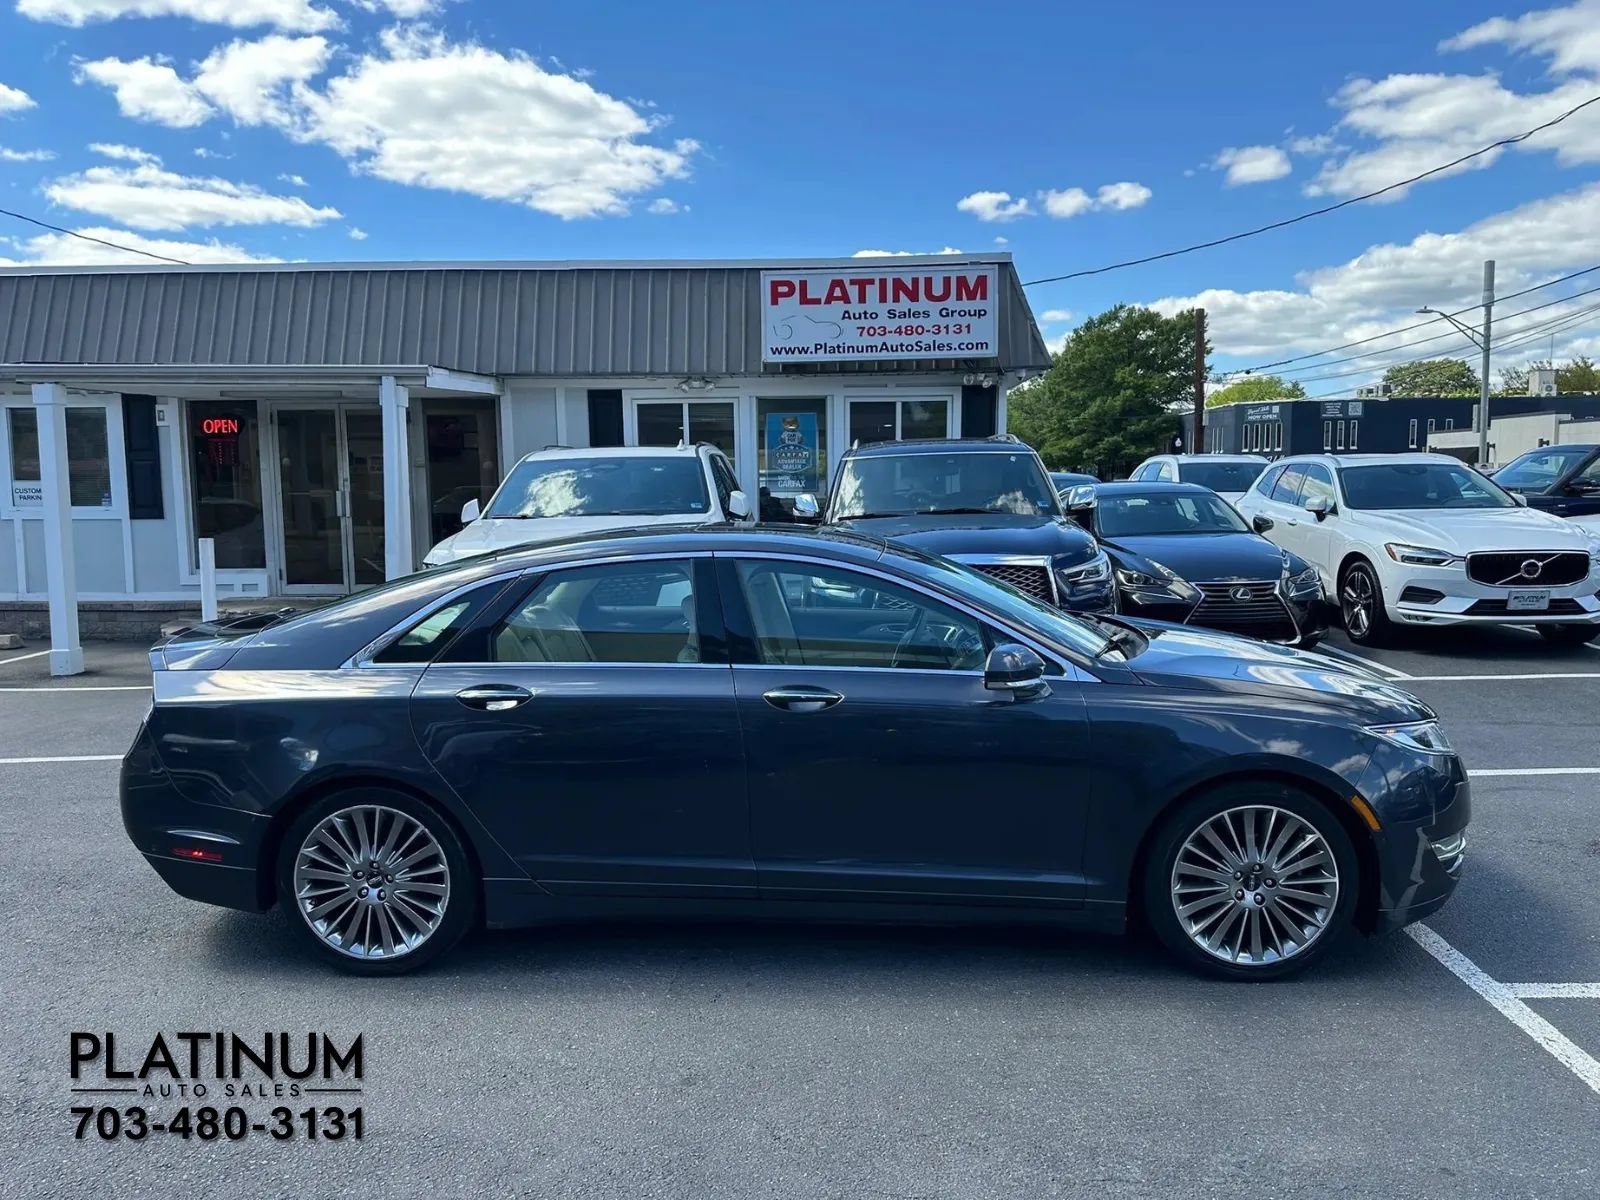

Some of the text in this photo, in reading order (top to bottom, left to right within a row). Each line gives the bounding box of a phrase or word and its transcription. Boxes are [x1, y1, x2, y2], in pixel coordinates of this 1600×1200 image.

[770, 274, 988, 306] PLATINUM
[841, 307, 988, 321] Auto Sales Group
[856, 324, 972, 337] 703-480-3131
[770, 340, 989, 356] www.PlatinumAutoSales.com
[203, 419, 238, 434] OPEN
[778, 480, 806, 488] CARFAX
